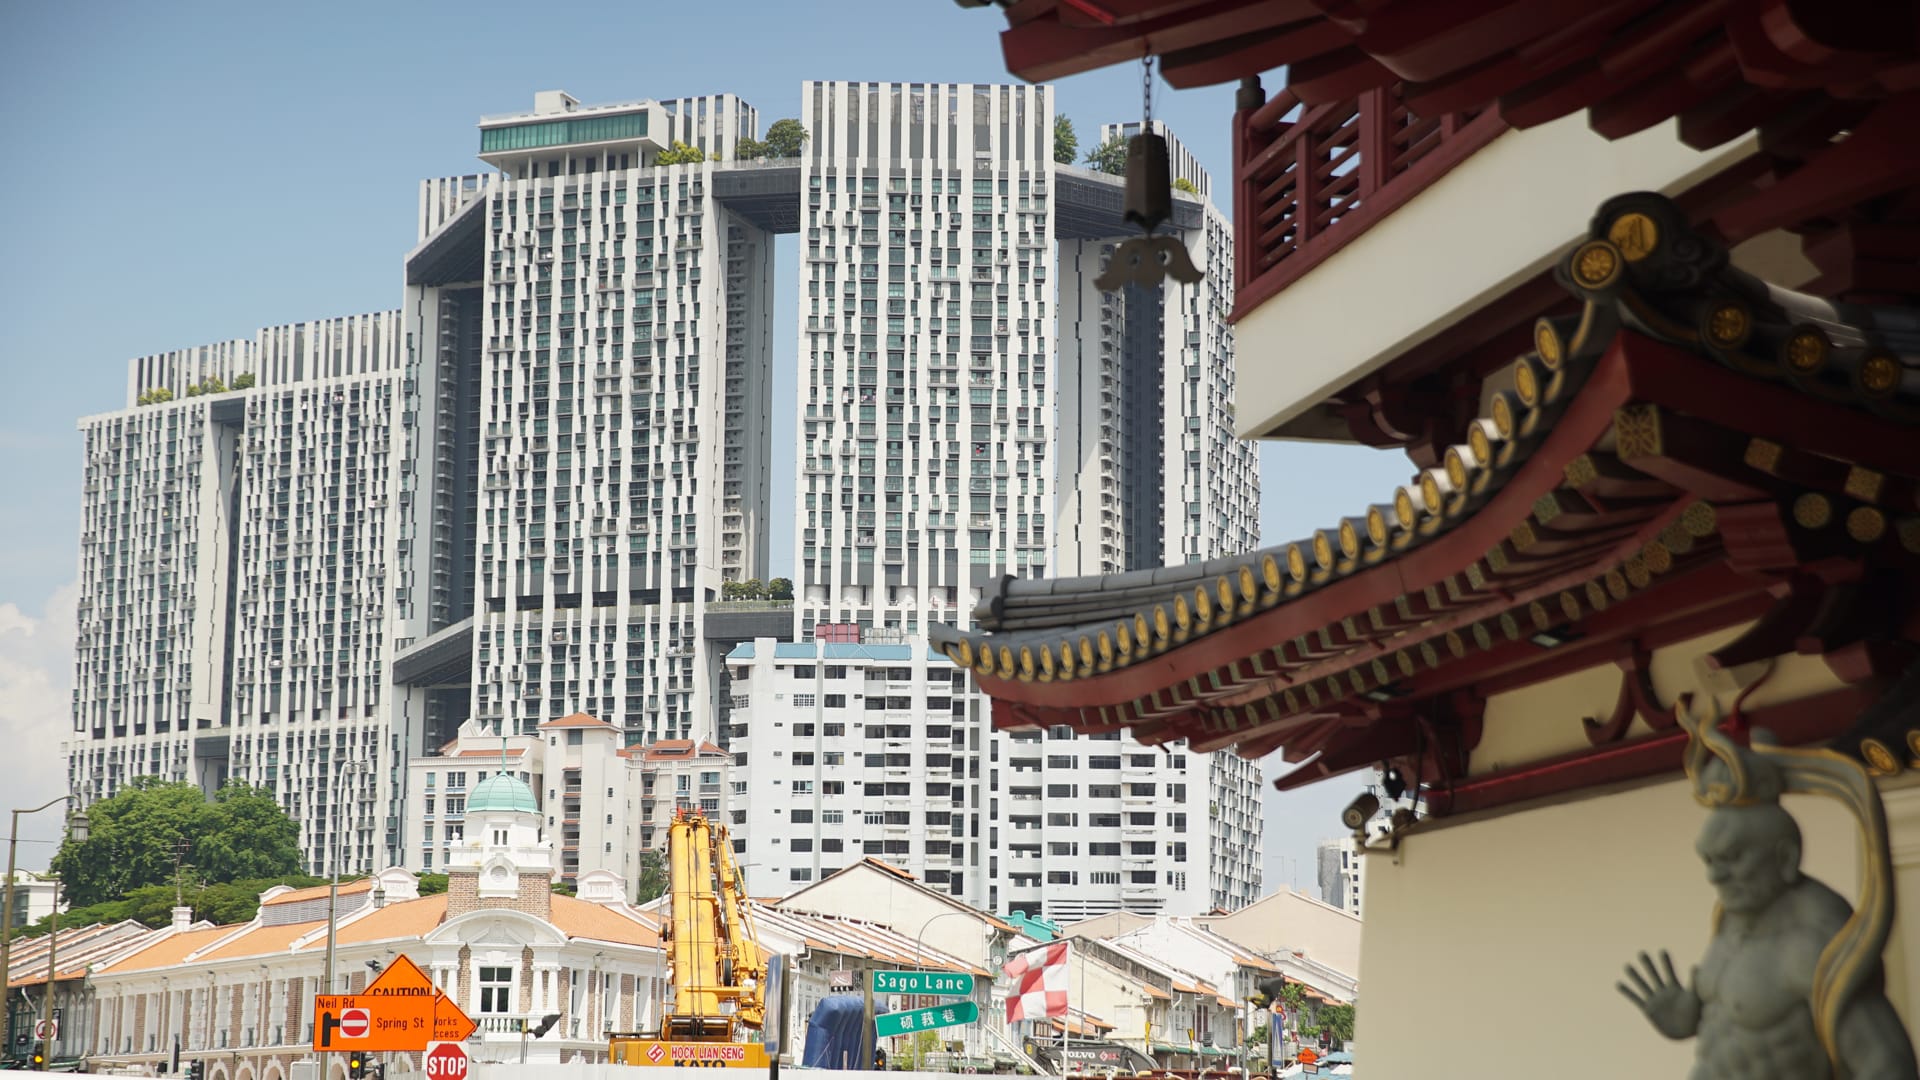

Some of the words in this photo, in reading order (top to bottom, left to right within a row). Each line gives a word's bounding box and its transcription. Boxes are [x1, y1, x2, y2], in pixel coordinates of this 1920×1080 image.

[878, 973, 917, 991] Sago
[925, 974, 964, 990] Lane
[373, 987, 430, 996] CAUTION
[318, 997, 336, 1008] Neil
[342, 997, 355, 1008] Rd
[376, 1017, 408, 1031] Spring
[413, 1017, 425, 1028] St
[900, 1008, 956, 1029] 硕莪巷
[434, 1030, 460, 1038] ccess
[671, 1046, 695, 1059] HOCK
[699, 1047, 719, 1059] LIAN
[721, 1047, 744, 1060] SENG
[1060, 1051, 1096, 1059] VOLVO
[428, 1056, 466, 1076] STOP
[674, 1060, 726, 1068] KATO
